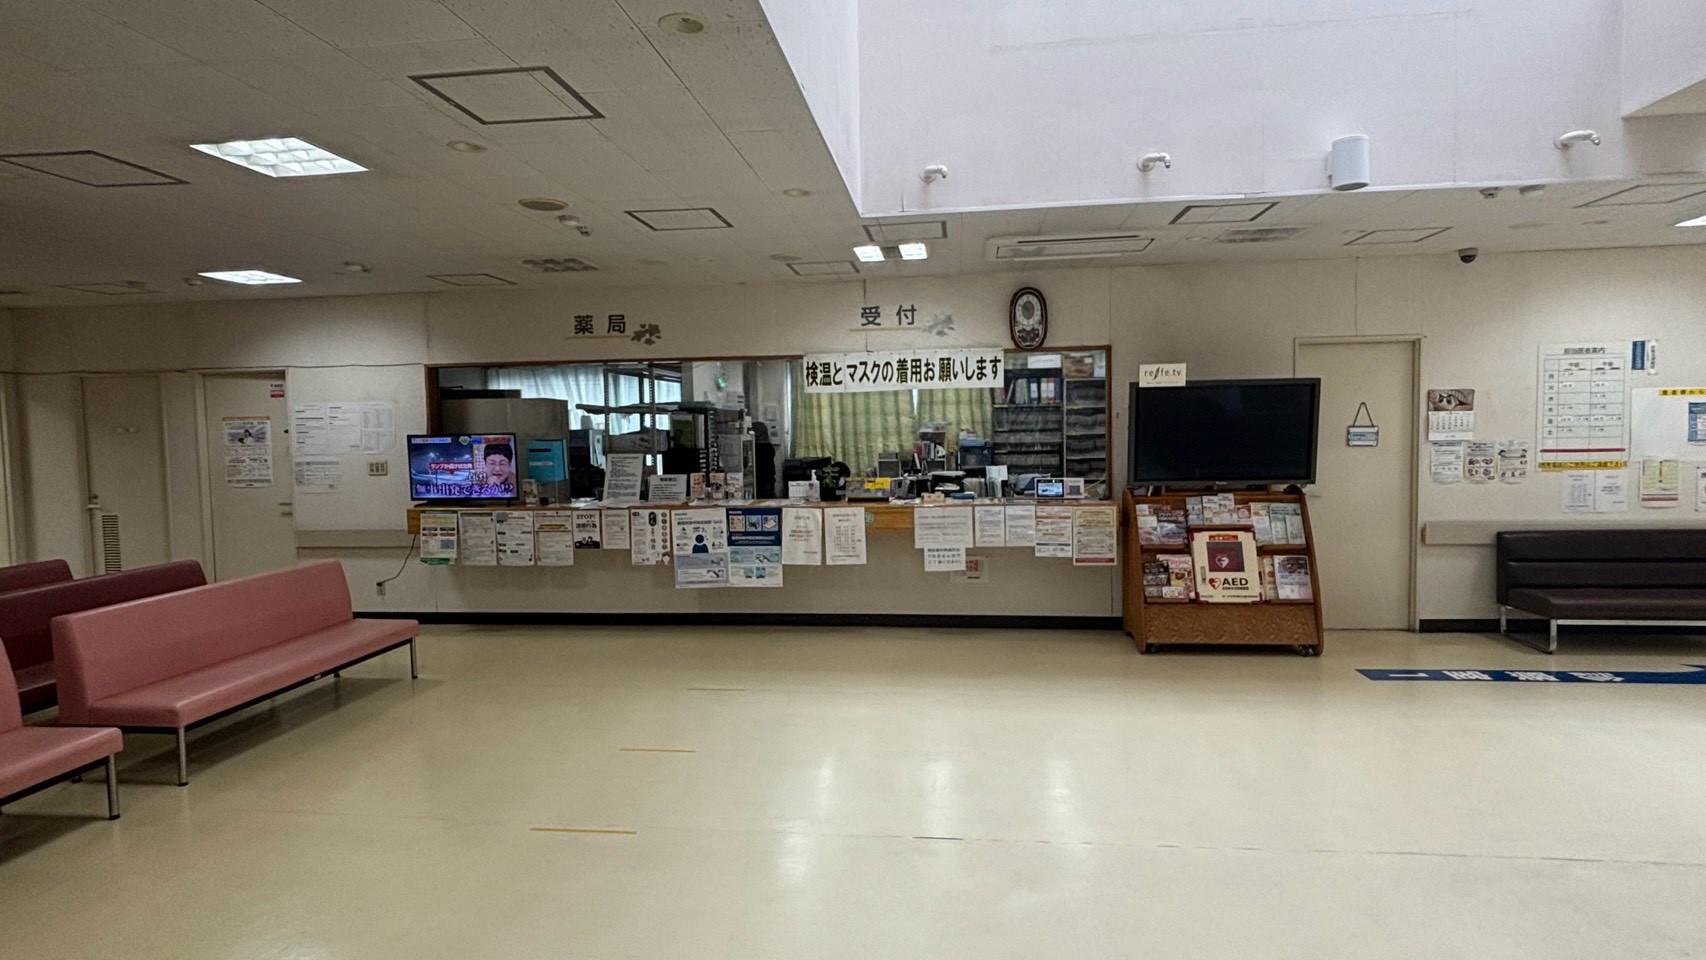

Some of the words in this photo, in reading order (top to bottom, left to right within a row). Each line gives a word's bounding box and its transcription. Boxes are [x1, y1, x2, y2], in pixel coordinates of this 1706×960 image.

[573, 314, 627, 335] 薬局
[860, 305, 917, 327] 受付
[805, 356, 1002, 387] 検温とマスクの着用お願いします
[1222, 578, 1249, 586] AED
